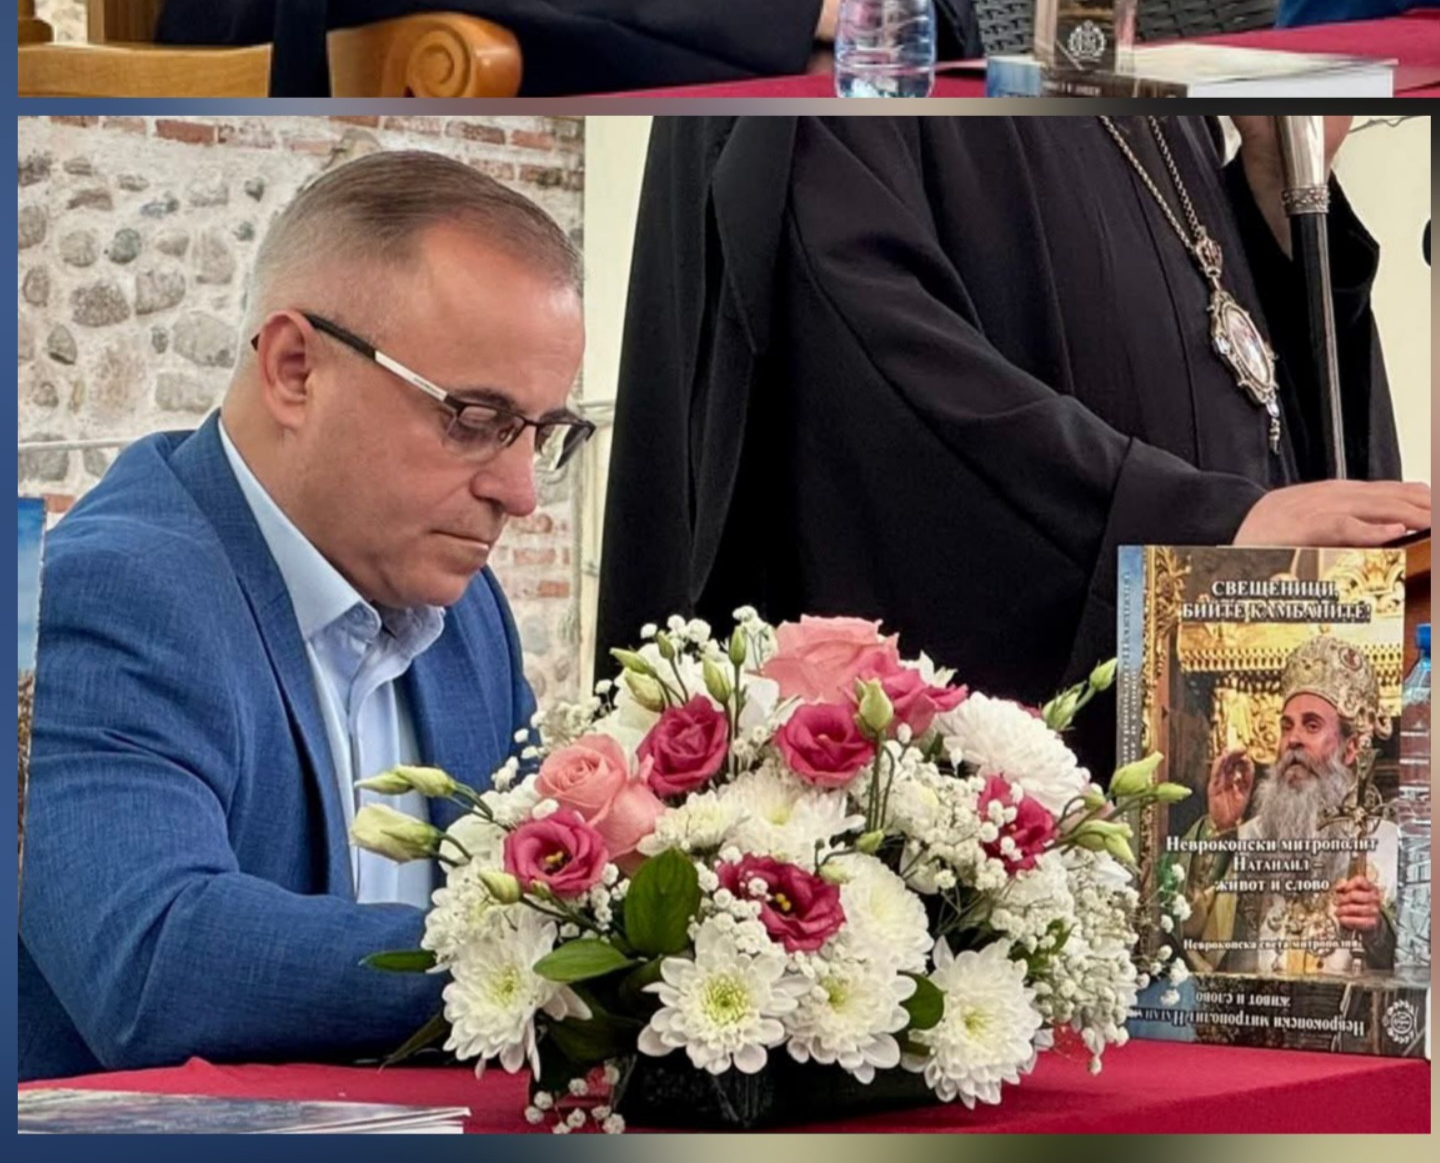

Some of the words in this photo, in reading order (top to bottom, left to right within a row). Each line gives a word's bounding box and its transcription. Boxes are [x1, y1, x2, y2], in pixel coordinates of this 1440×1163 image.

[1166, 836, 1277, 854] Неврокопски
[1281, 838, 1378, 854] митрополит
[1214, 880, 1266, 892] живот
[1270, 880, 1281, 892] и
[1284, 880, 1330, 892] слово
